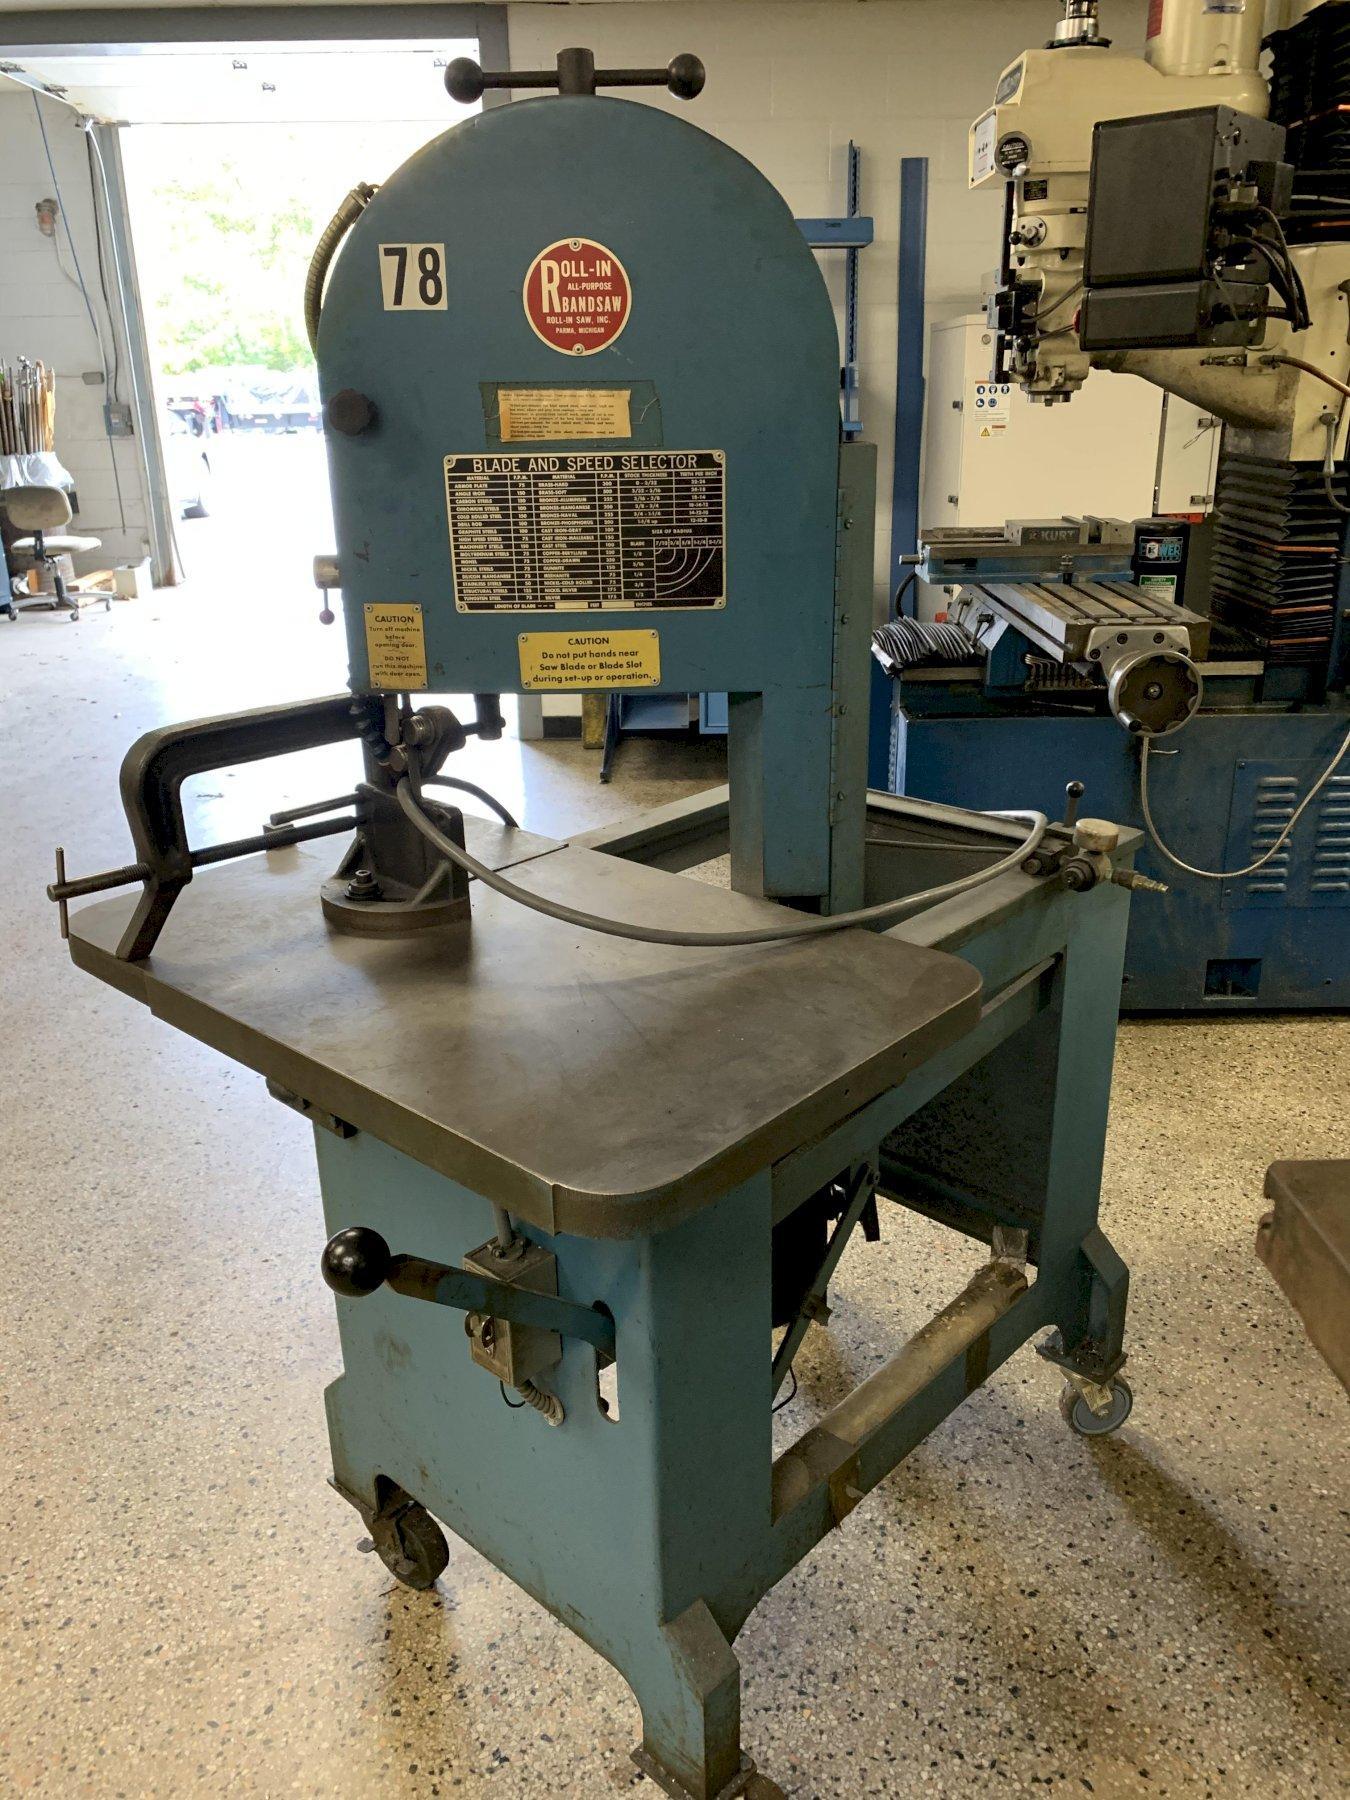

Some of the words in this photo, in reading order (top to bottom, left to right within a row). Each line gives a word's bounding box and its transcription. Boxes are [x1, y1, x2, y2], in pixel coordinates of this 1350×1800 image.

[384, 247, 442, 305] 78
[563, 296, 621, 312] BANDSAW
[547, 316, 573, 324] ROLL-IN
[577, 316, 593, 324] SAW,
[473, 459, 520, 472] BLADE
[528, 457, 559, 472] AND
[567, 457, 613, 471] SPEED
[621, 455, 697, 469] SELECTOR
[568, 637, 609, 645] CAUTION
[573, 652, 587, 660] put
[533, 674, 562, 683] during
[565, 675, 592, 683] set-up
[606, 672, 652, 681] operation.
